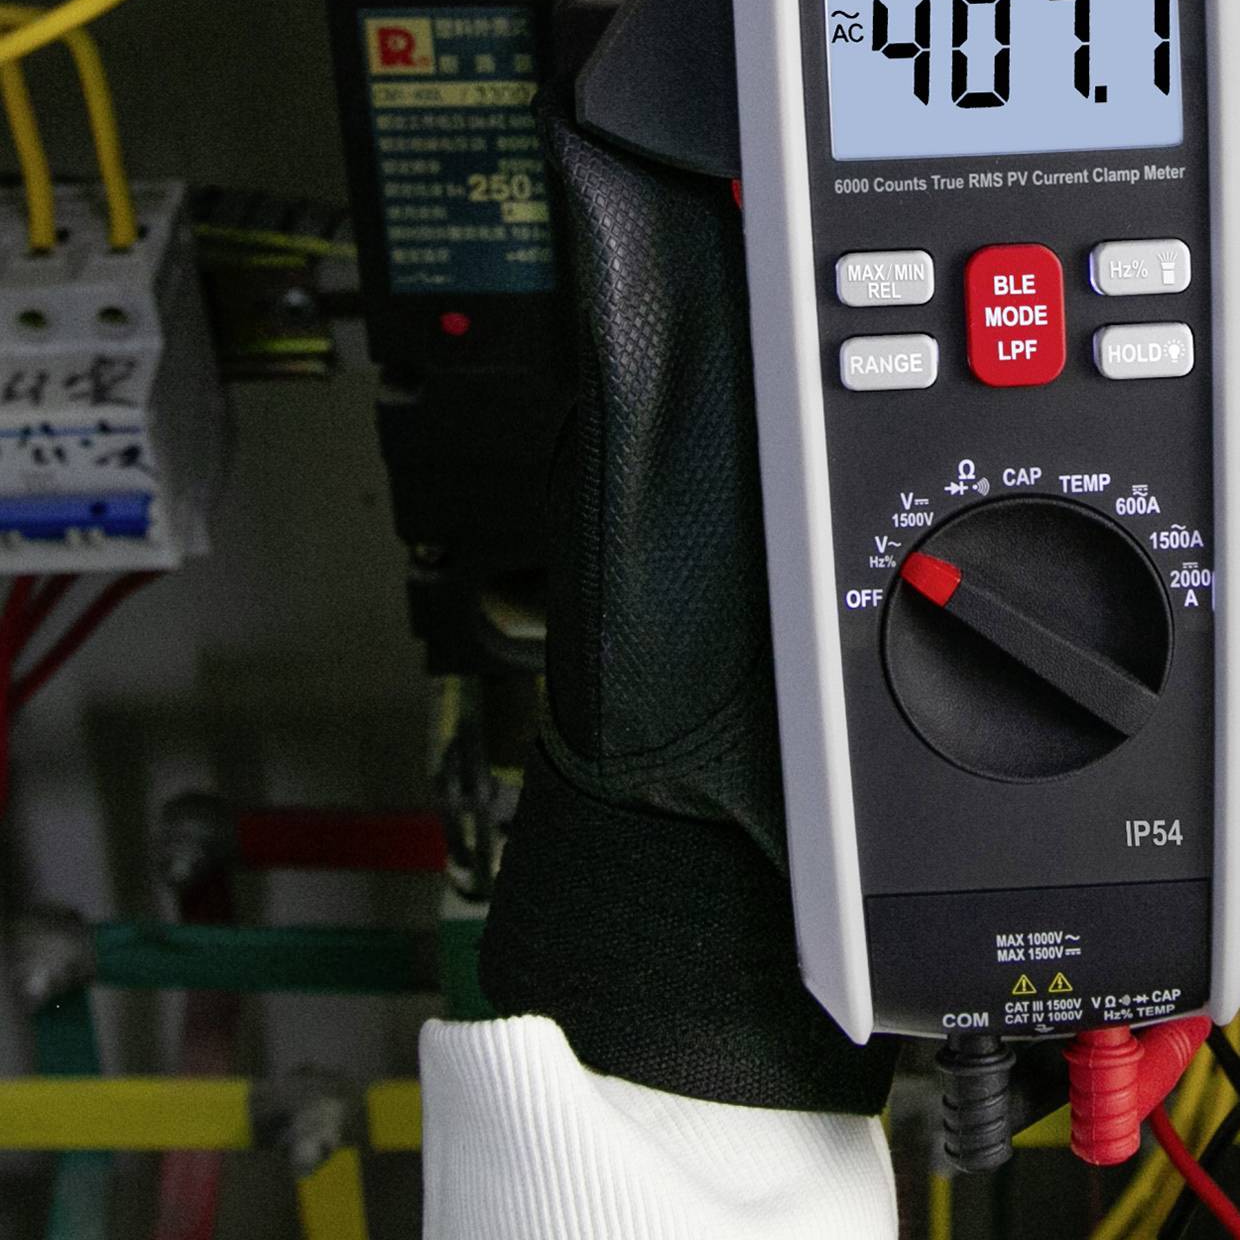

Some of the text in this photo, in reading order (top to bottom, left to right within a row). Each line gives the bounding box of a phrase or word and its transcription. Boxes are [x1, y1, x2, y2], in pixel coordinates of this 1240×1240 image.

[832, 23, 864, 43] AC
[467, 173, 532, 201] 250
[835, 165, 1185, 193] 6000 Counts True RMS PV Current Clamp Meter
[1109, 260, 1149, 280] Hz%
[868, 282, 902, 298] REL
[994, 275, 1036, 295] BLE
[985, 305, 1047, 326] MODE
[999, 340, 1037, 360] LPF
[1108, 343, 1162, 363] HOLD
[850, 354, 923, 374] RANGE
[1003, 468, 1041, 486] CAP
[1059, 474, 1110, 492] TEMP
[901, 493, 913, 509] V
[1116, 496, 1160, 514] 600A
[892, 512, 933, 527] 1500V
[875, 536, 891, 553] V
[1150, 531, 1203, 549] 1500A
[870, 556, 896, 567] Hz%
[1169, 570, 1211, 589] 2000
[847, 590, 882, 608] OFF
[1185, 589, 1198, 606] A
[1126, 820, 1183, 846] IP54
[995, 931, 1063, 948] MAX 1000V
[997, 946, 1064, 962] MAX 1500V
[1005, 997, 1083, 1013] CAT III 1500V
[1091, 996, 1101, 1009] V
[1151, 988, 1182, 1003] CAP
[943, 1012, 988, 1027] COM
[1005, 1010, 1083, 1024] CAT IV 1000V
[1103, 1004, 1176, 1021] Hz% TEMP
